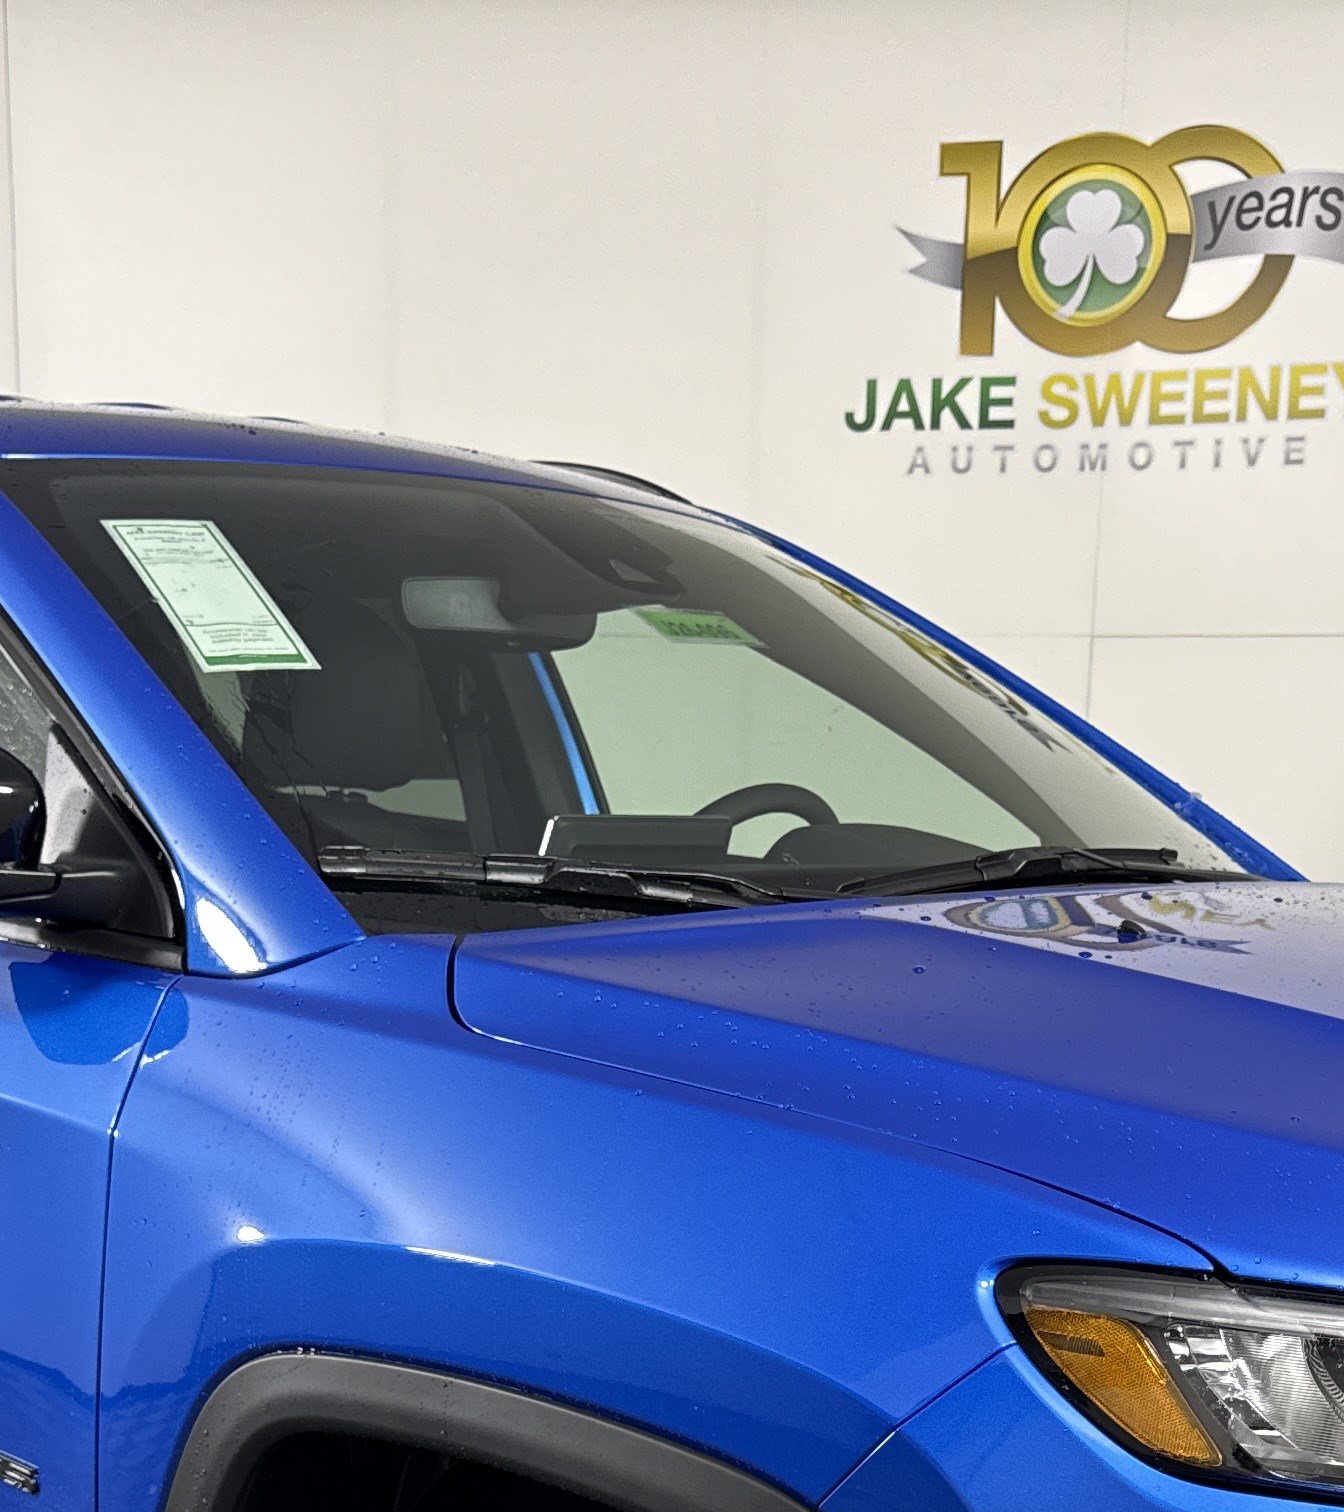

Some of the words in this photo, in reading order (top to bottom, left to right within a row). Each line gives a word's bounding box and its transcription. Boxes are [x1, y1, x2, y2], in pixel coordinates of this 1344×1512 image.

[939, 124, 1297, 358] 100
[1203, 182, 1344, 251] years
[844, 375, 1017, 433] JAKE
[906, 434, 1309, 475] AUTOMOTIVE
